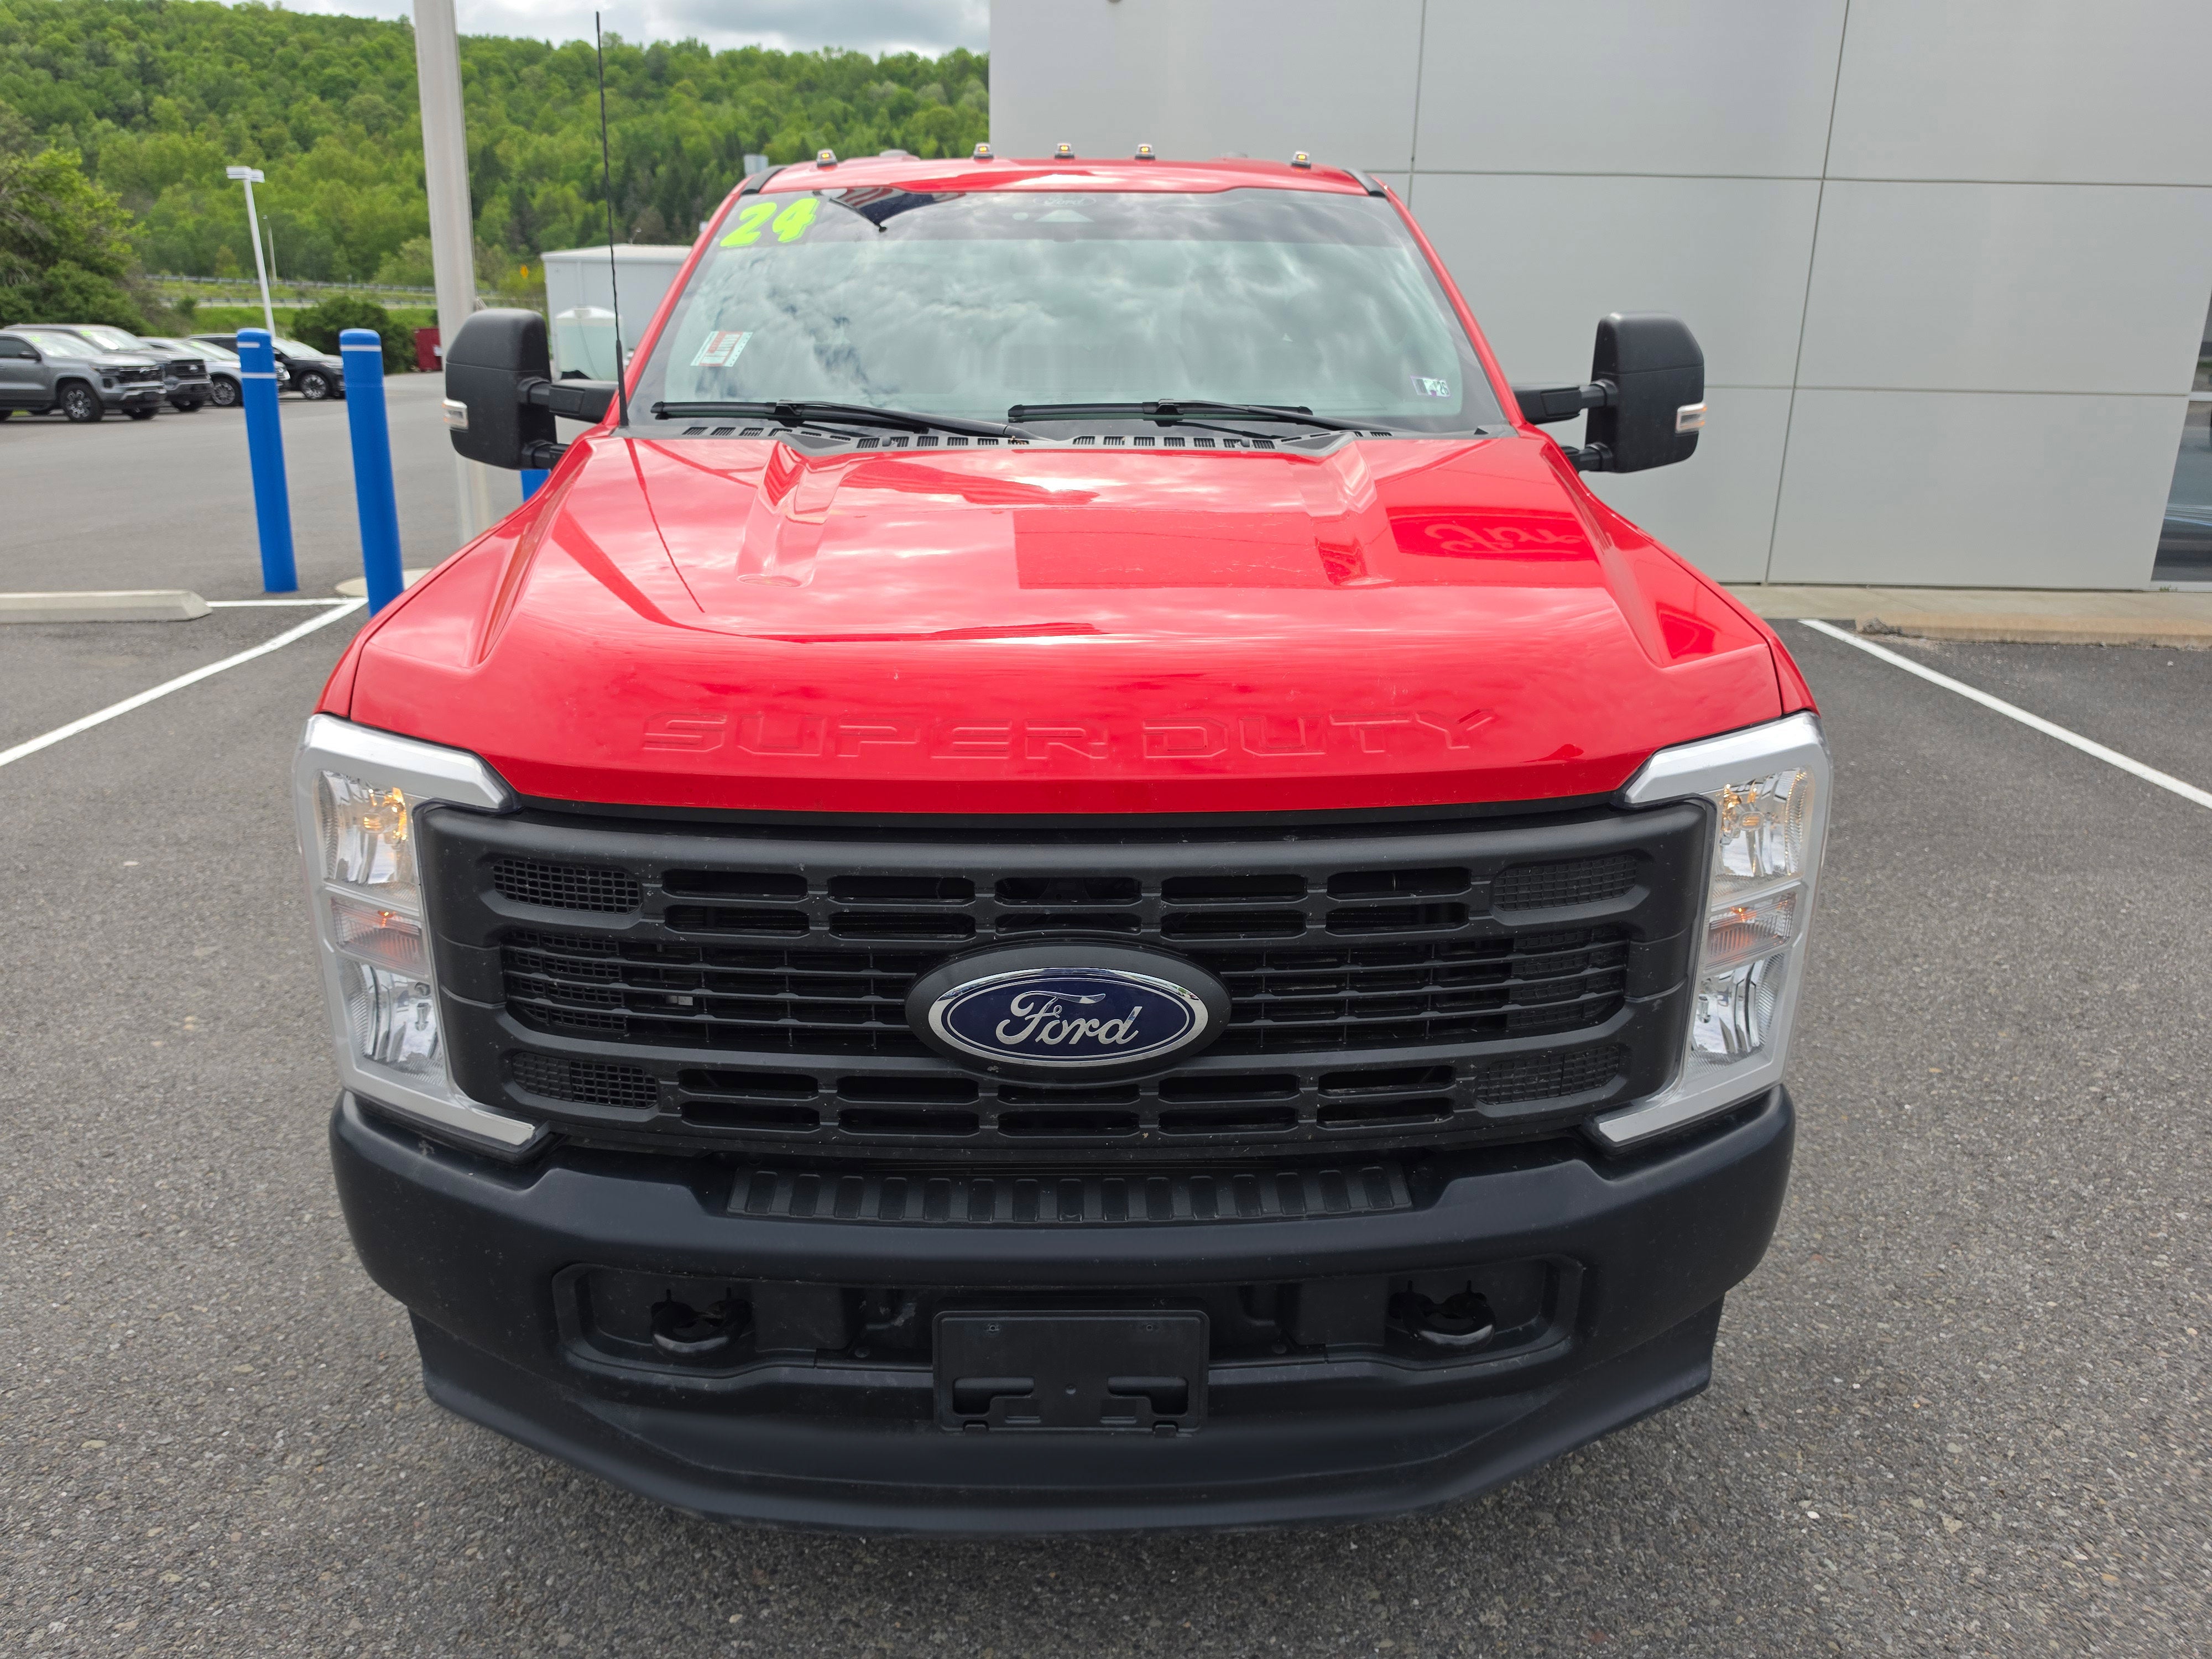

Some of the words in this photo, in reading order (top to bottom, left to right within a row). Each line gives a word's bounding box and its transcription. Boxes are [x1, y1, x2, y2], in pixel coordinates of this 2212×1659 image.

[719, 197, 820, 248] 24
[642, 712, 1108, 759] SUPER
[1142, 708, 1494, 758] DUTY
[995, 990, 1142, 1045] Ford
